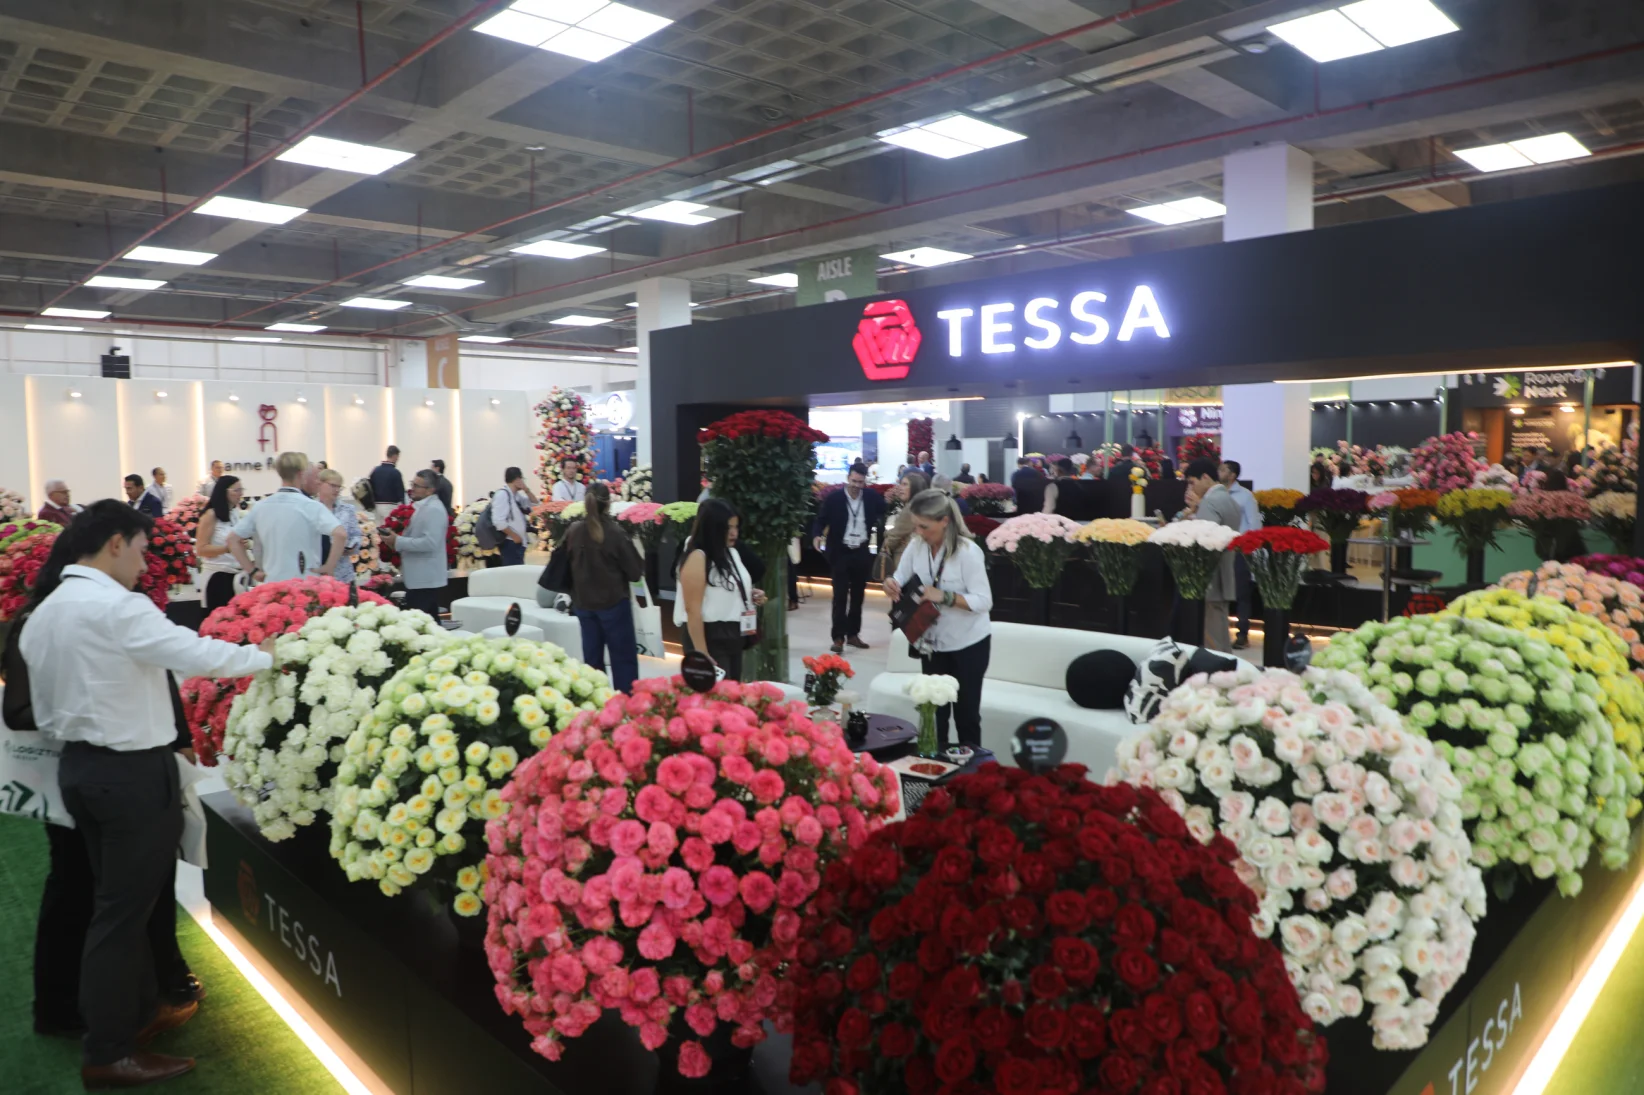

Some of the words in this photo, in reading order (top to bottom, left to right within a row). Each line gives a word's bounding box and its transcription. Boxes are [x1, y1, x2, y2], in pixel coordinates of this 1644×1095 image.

[817, 257, 852, 281] AISLE
[937, 285, 1171, 357] TESSA
[1524, 384, 1568, 399] Next
[264, 892, 342, 998] TESSA
[1448, 981, 1522, 1095] TESSA
